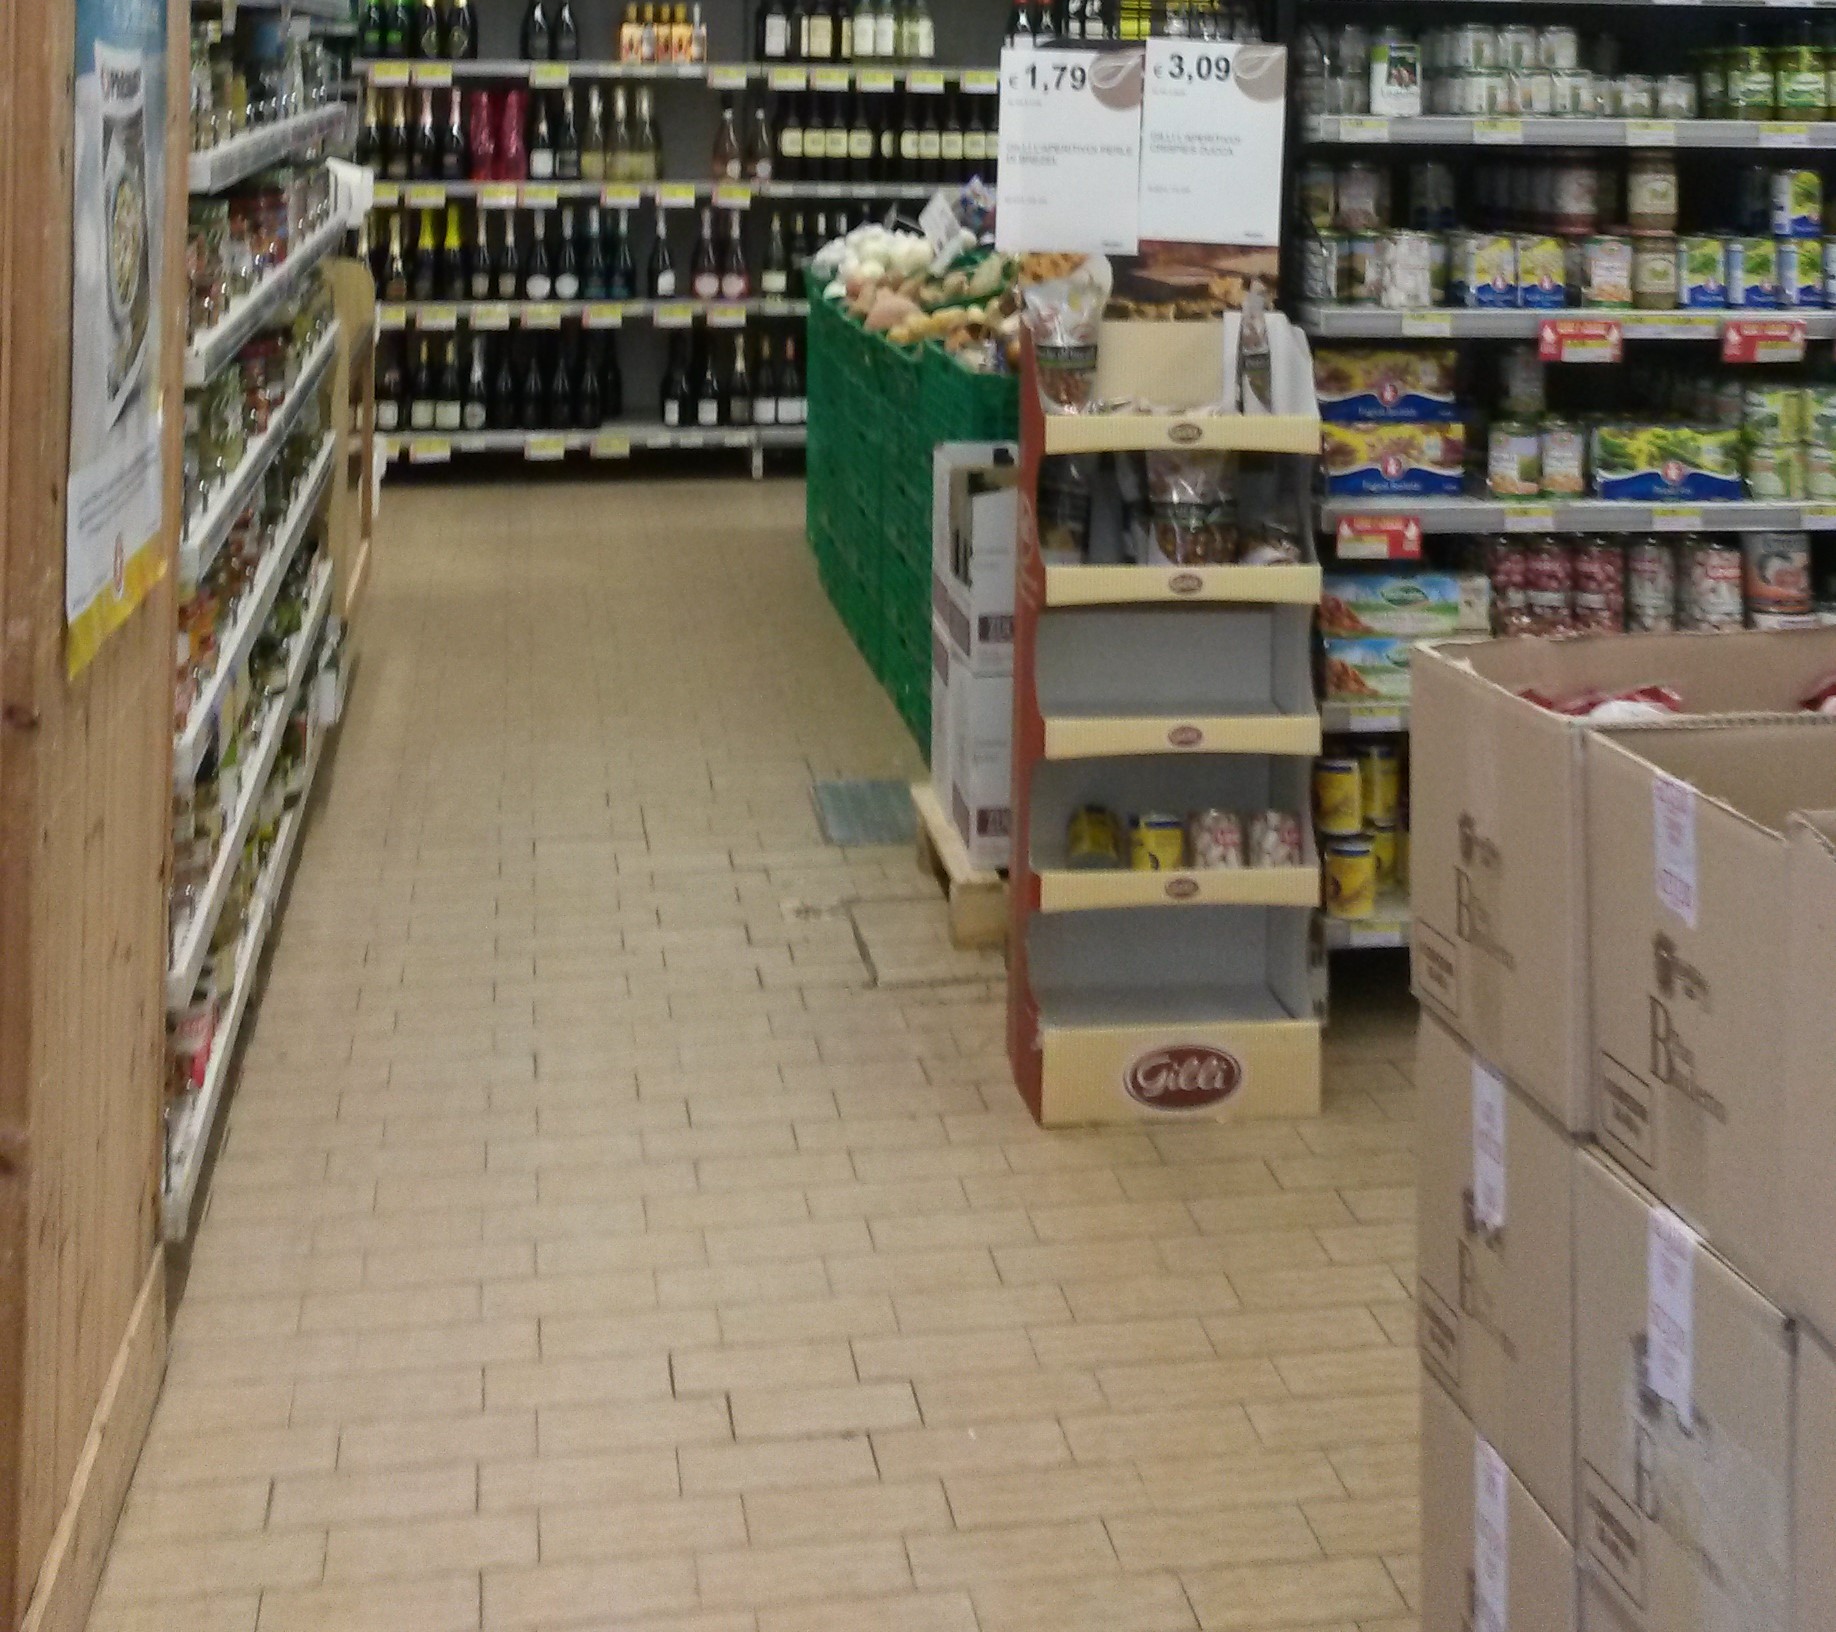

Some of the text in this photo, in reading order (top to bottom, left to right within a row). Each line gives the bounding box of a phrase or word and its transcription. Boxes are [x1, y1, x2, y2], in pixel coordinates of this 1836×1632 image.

[1025, 63, 1086, 91] 1,79
[1168, 54, 1230, 82] 3,09
[1136, 1054, 1228, 1098] Gilli
